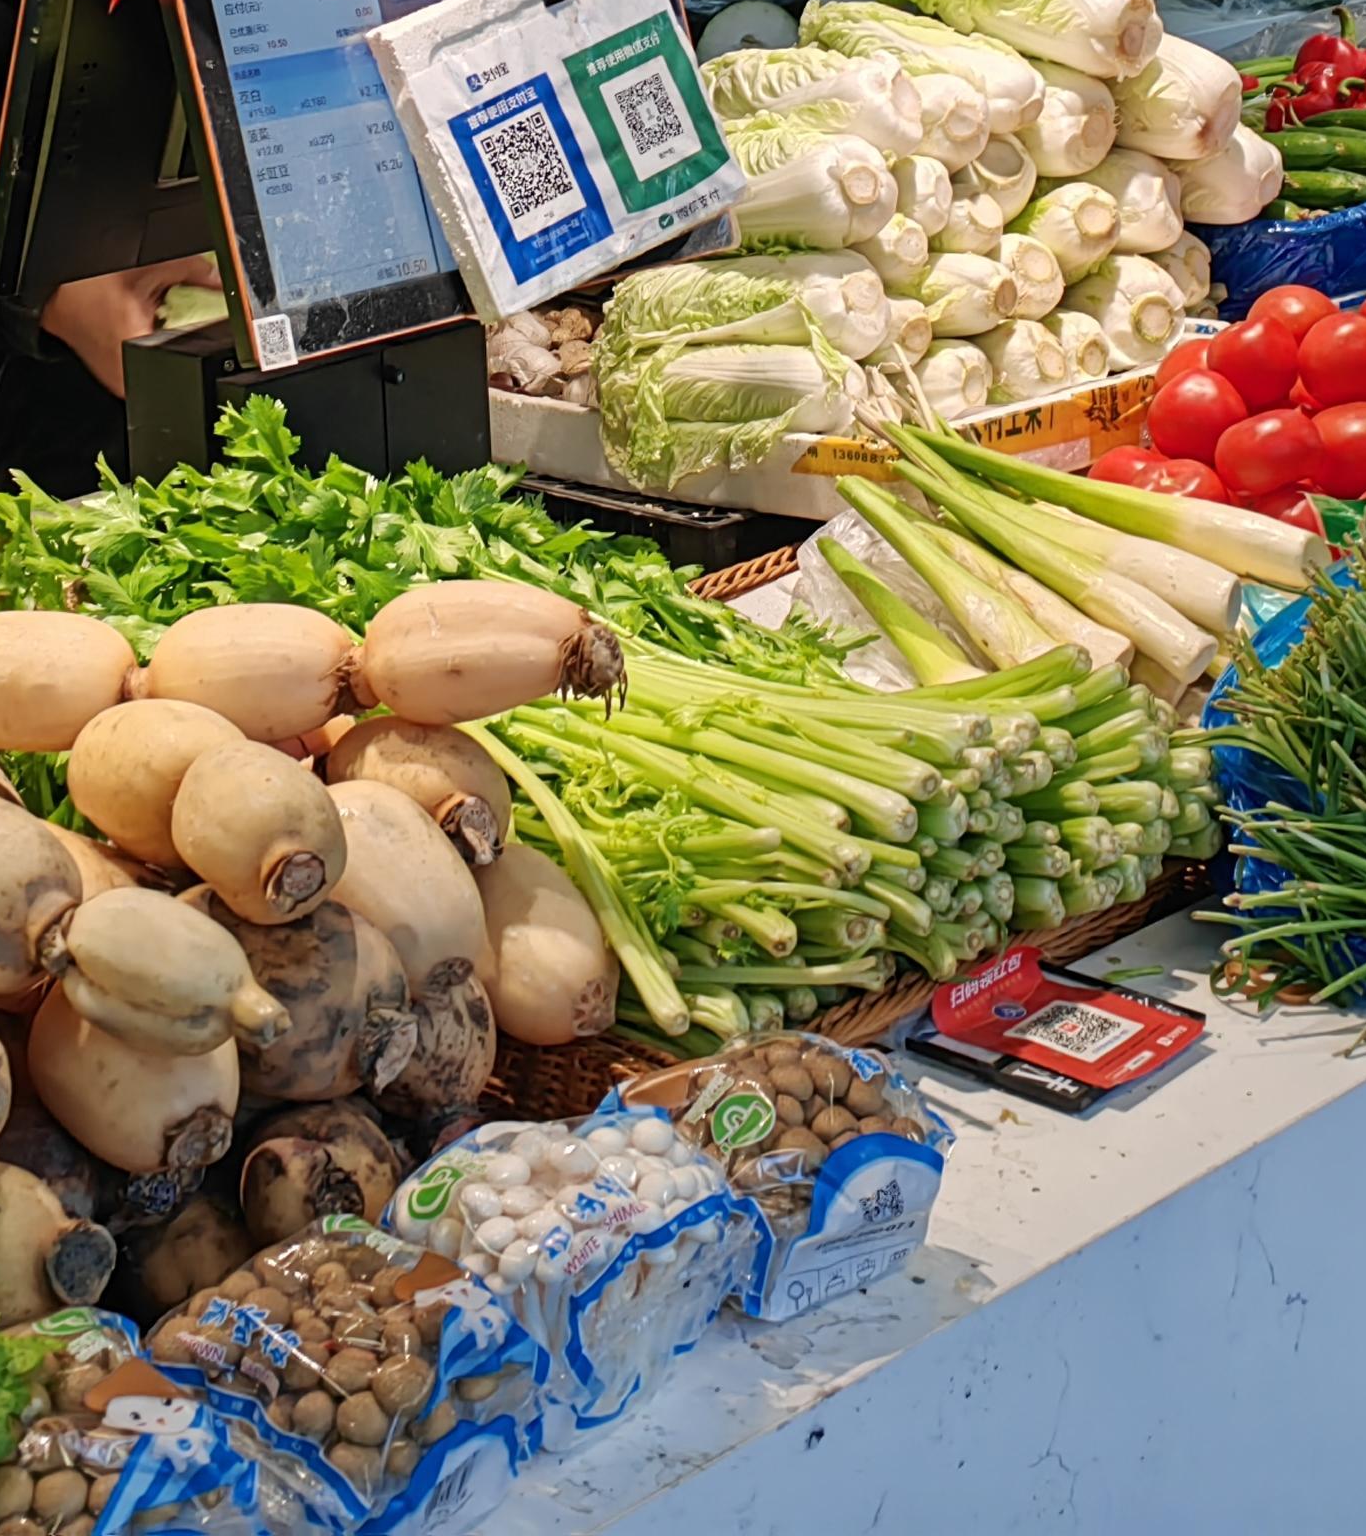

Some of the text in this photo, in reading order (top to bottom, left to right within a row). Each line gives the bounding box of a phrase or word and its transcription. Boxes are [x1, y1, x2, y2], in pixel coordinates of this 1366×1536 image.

[480, 61, 510, 85] 支付宝
[467, 86, 539, 131] 推荐使用支付宝
[675, 188, 722, 221] 微信支付
[562, 1234, 602, 1278] WHITE
